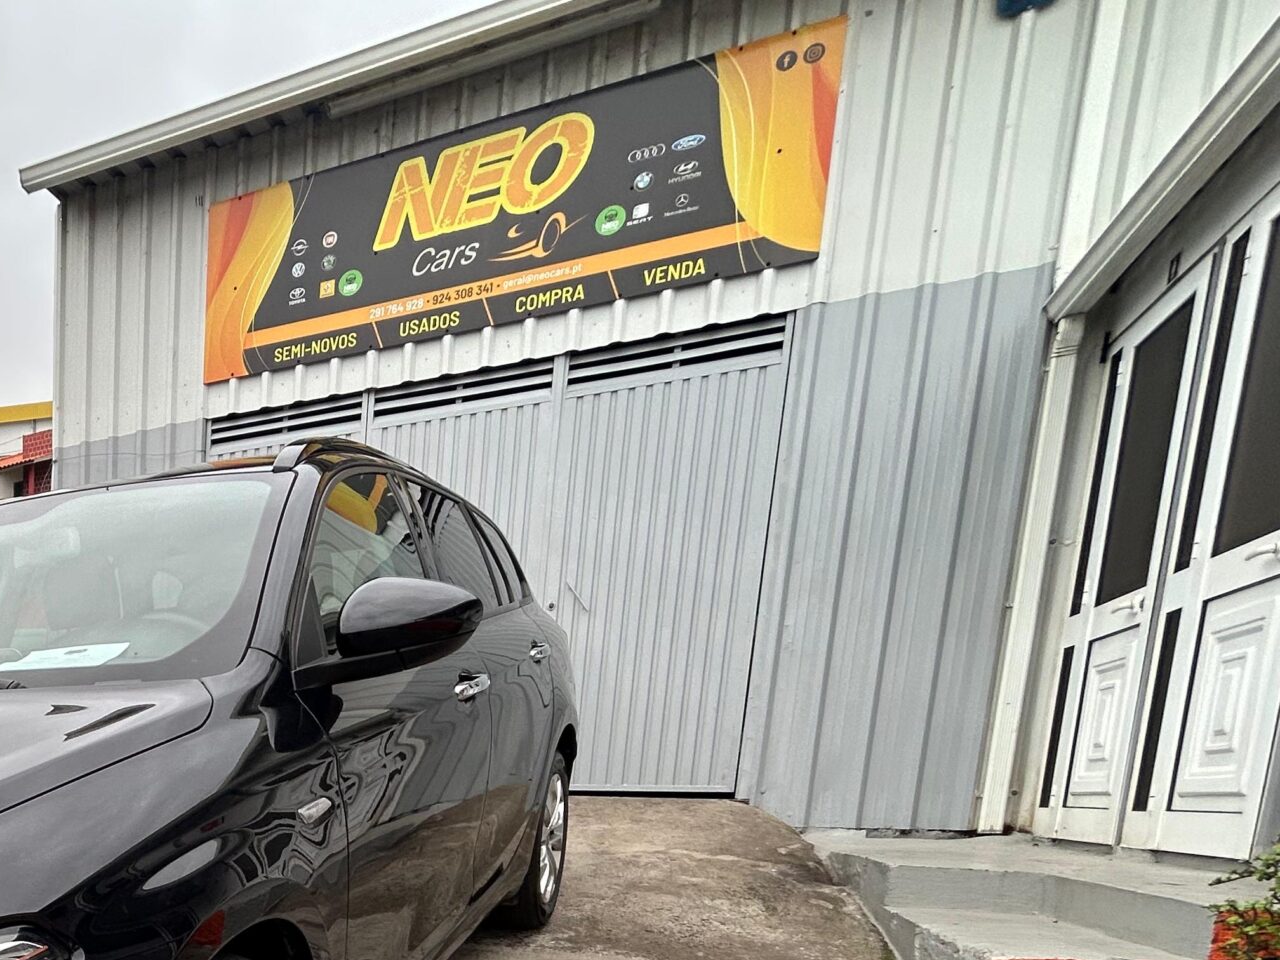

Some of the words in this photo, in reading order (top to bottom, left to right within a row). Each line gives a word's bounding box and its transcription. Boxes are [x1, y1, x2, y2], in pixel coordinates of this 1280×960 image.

[373, 112, 594, 251] NEO
[412, 242, 479, 276] Cars
[643, 258, 706, 286] VENDA
[406, 298, 424, 310] 928
[432, 292, 451, 305] 924
[454, 287, 473, 300] 308
[476, 282, 493, 295] 341
[503, 263, 582, 289] geral@neocars.pt
[515, 284, 585, 313] COMPRA
[399, 311, 460, 336] USADOS
[274, 333, 357, 362] SEMI-NOVOS
